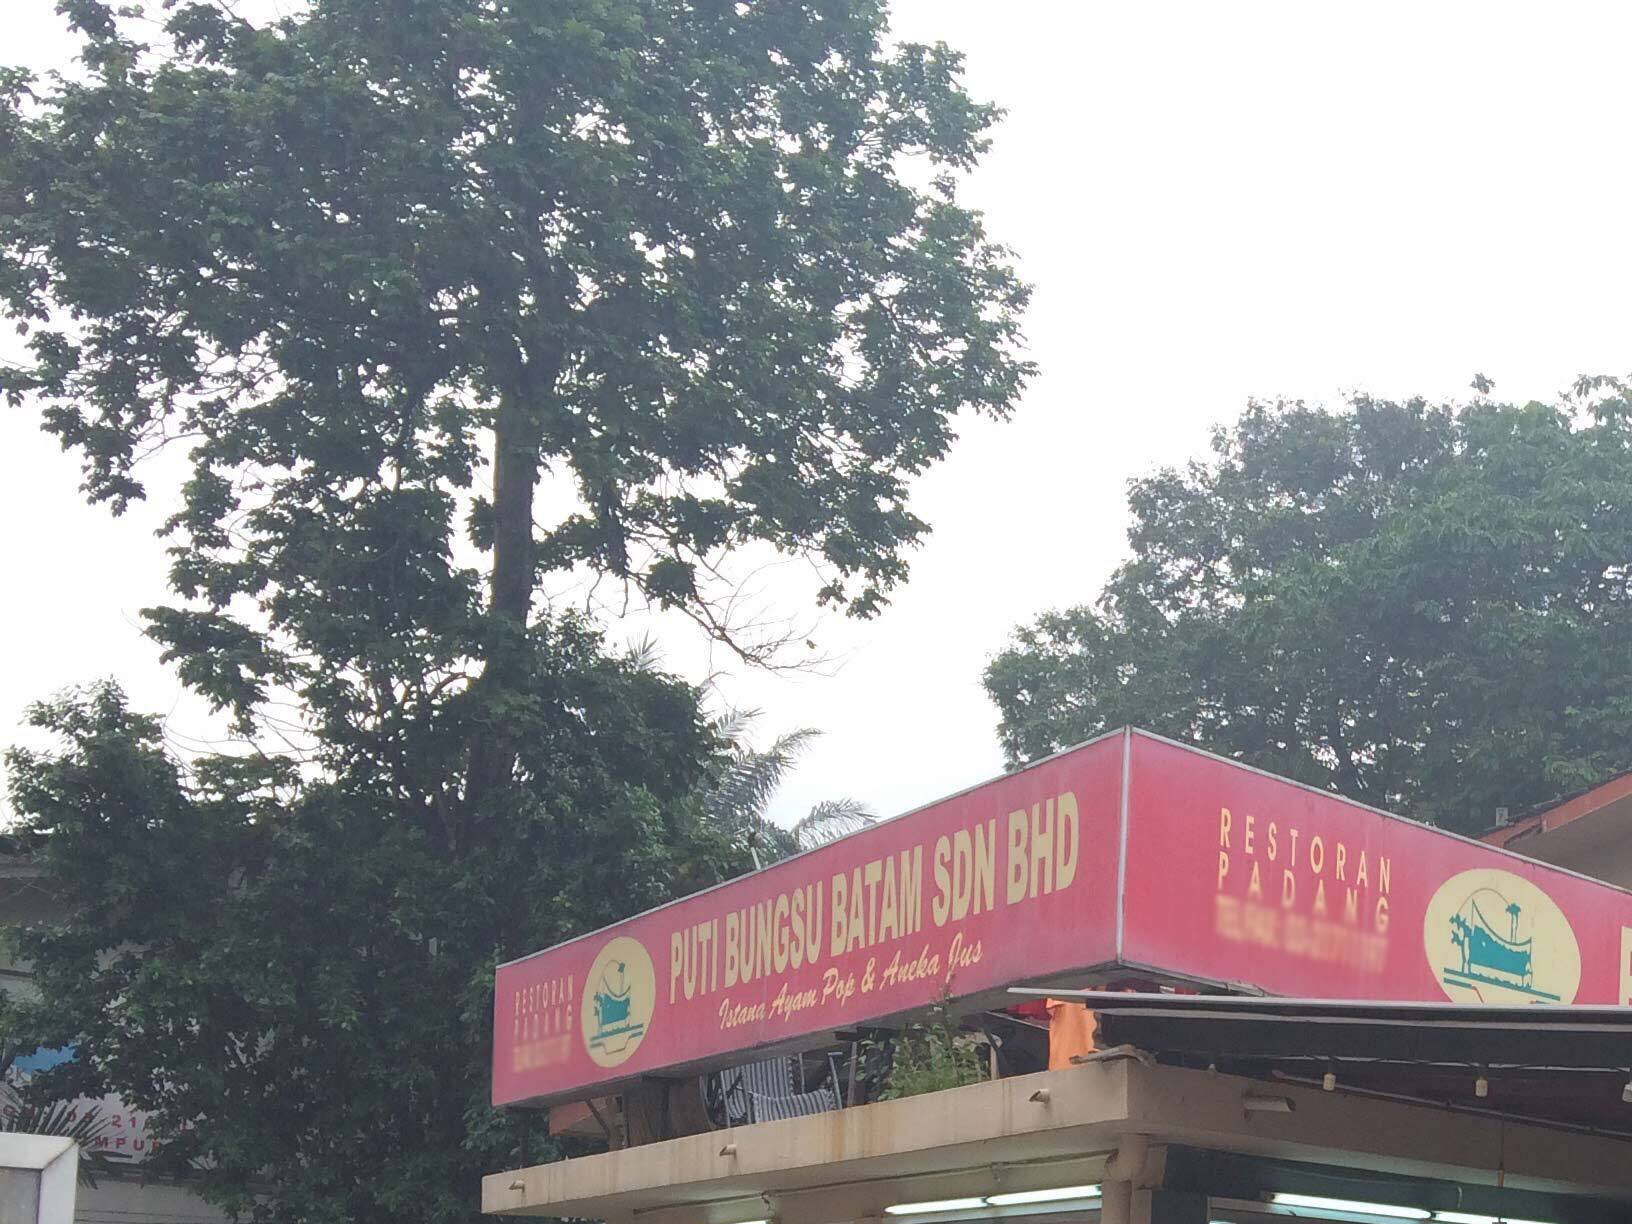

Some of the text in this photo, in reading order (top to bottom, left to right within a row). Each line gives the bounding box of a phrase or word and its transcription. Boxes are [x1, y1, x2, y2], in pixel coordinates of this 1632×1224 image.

[1218, 851, 1390, 933] PADANG
[1220, 807, 1391, 894] RESTORAN
[670, 791, 1080, 1005] PUTI BUNGSU BATAM SDN BHD
[719, 931, 984, 1030] Istana Ayam Pop & Aneka Jus
